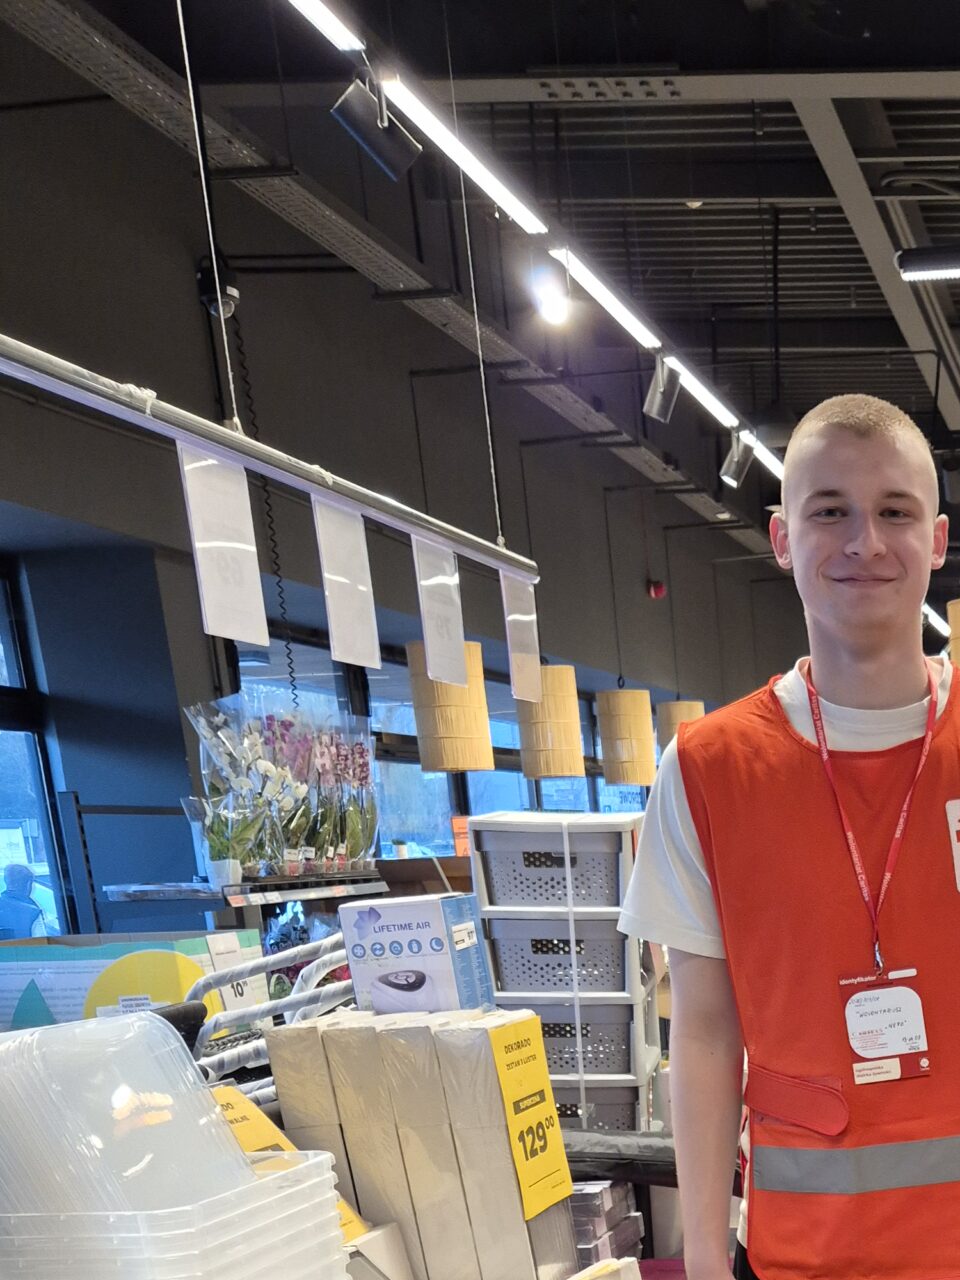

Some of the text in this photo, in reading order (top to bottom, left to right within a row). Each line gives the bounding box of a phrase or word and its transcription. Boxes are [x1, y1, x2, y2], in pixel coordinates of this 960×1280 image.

[373, 921, 431, 933] LIFETIME AIR
[504, 1037, 532, 1055] DEKORADO
